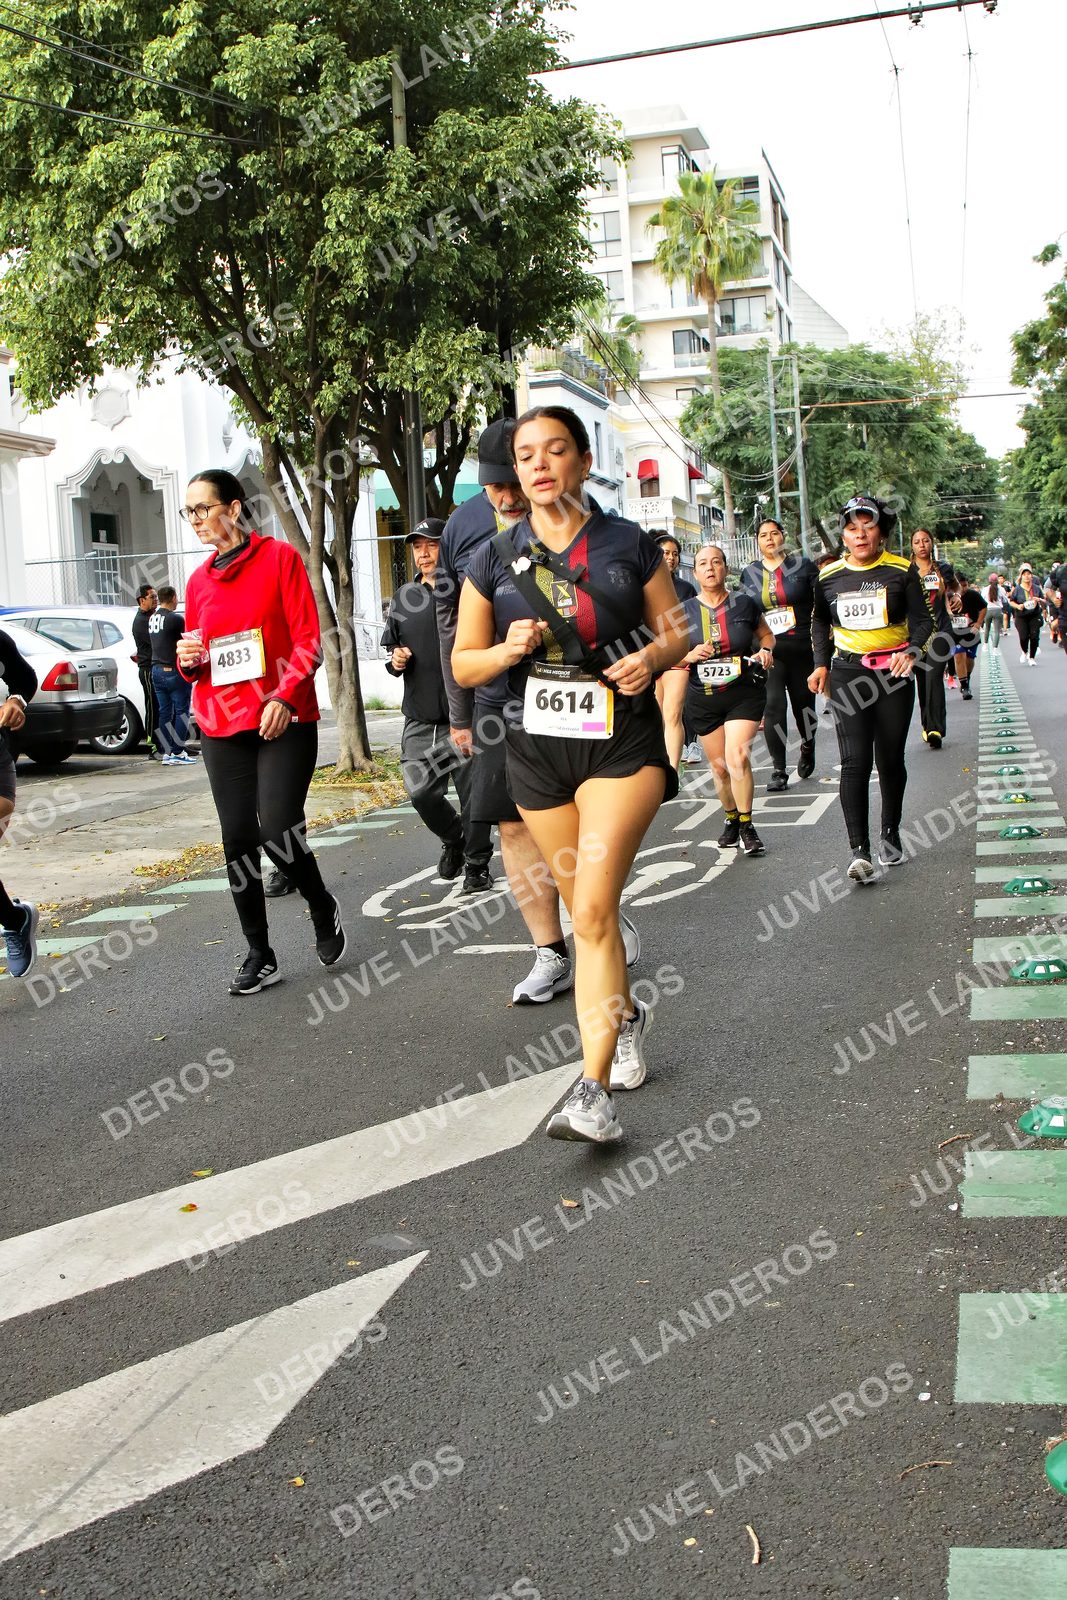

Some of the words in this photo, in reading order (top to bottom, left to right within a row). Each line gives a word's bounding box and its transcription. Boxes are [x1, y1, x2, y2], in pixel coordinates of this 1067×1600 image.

[844, 603, 875, 618] 3891
[767, 614, 788, 627] 7017
[217, 647, 251, 668] 4833
[703, 665, 731, 678] 5723
[535, 688, 595, 714] 6614
